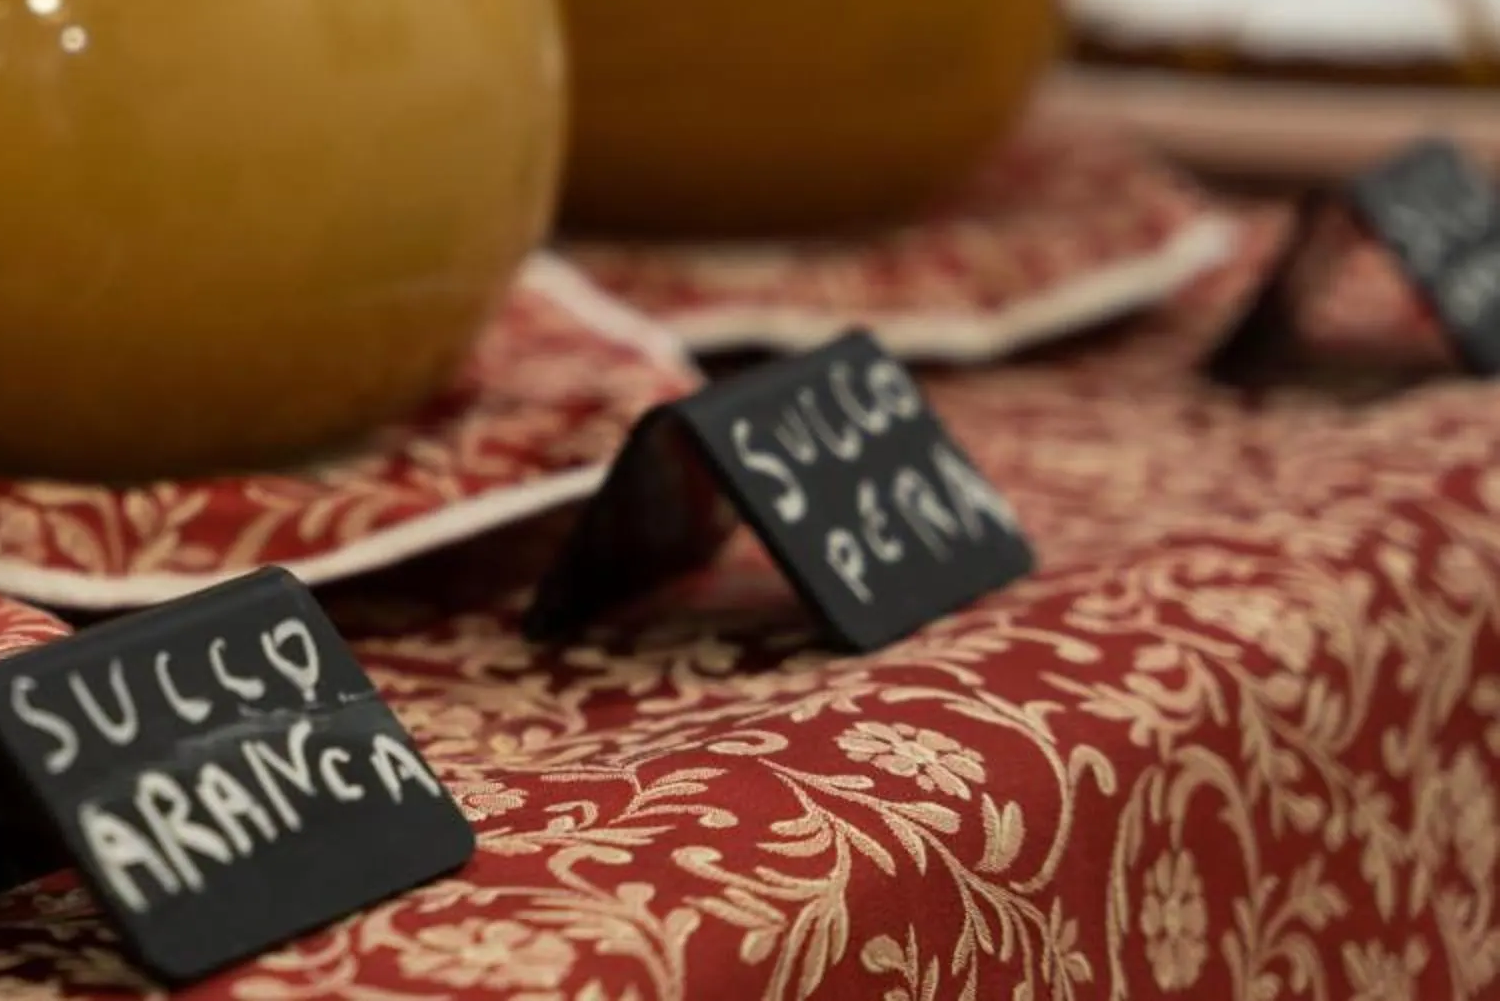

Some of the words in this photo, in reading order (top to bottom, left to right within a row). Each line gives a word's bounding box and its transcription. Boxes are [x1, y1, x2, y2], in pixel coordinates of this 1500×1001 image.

[732, 359, 919, 523] SUCCO
[825, 441, 1018, 604] PERA
[9, 617, 320, 774] SUCCO
